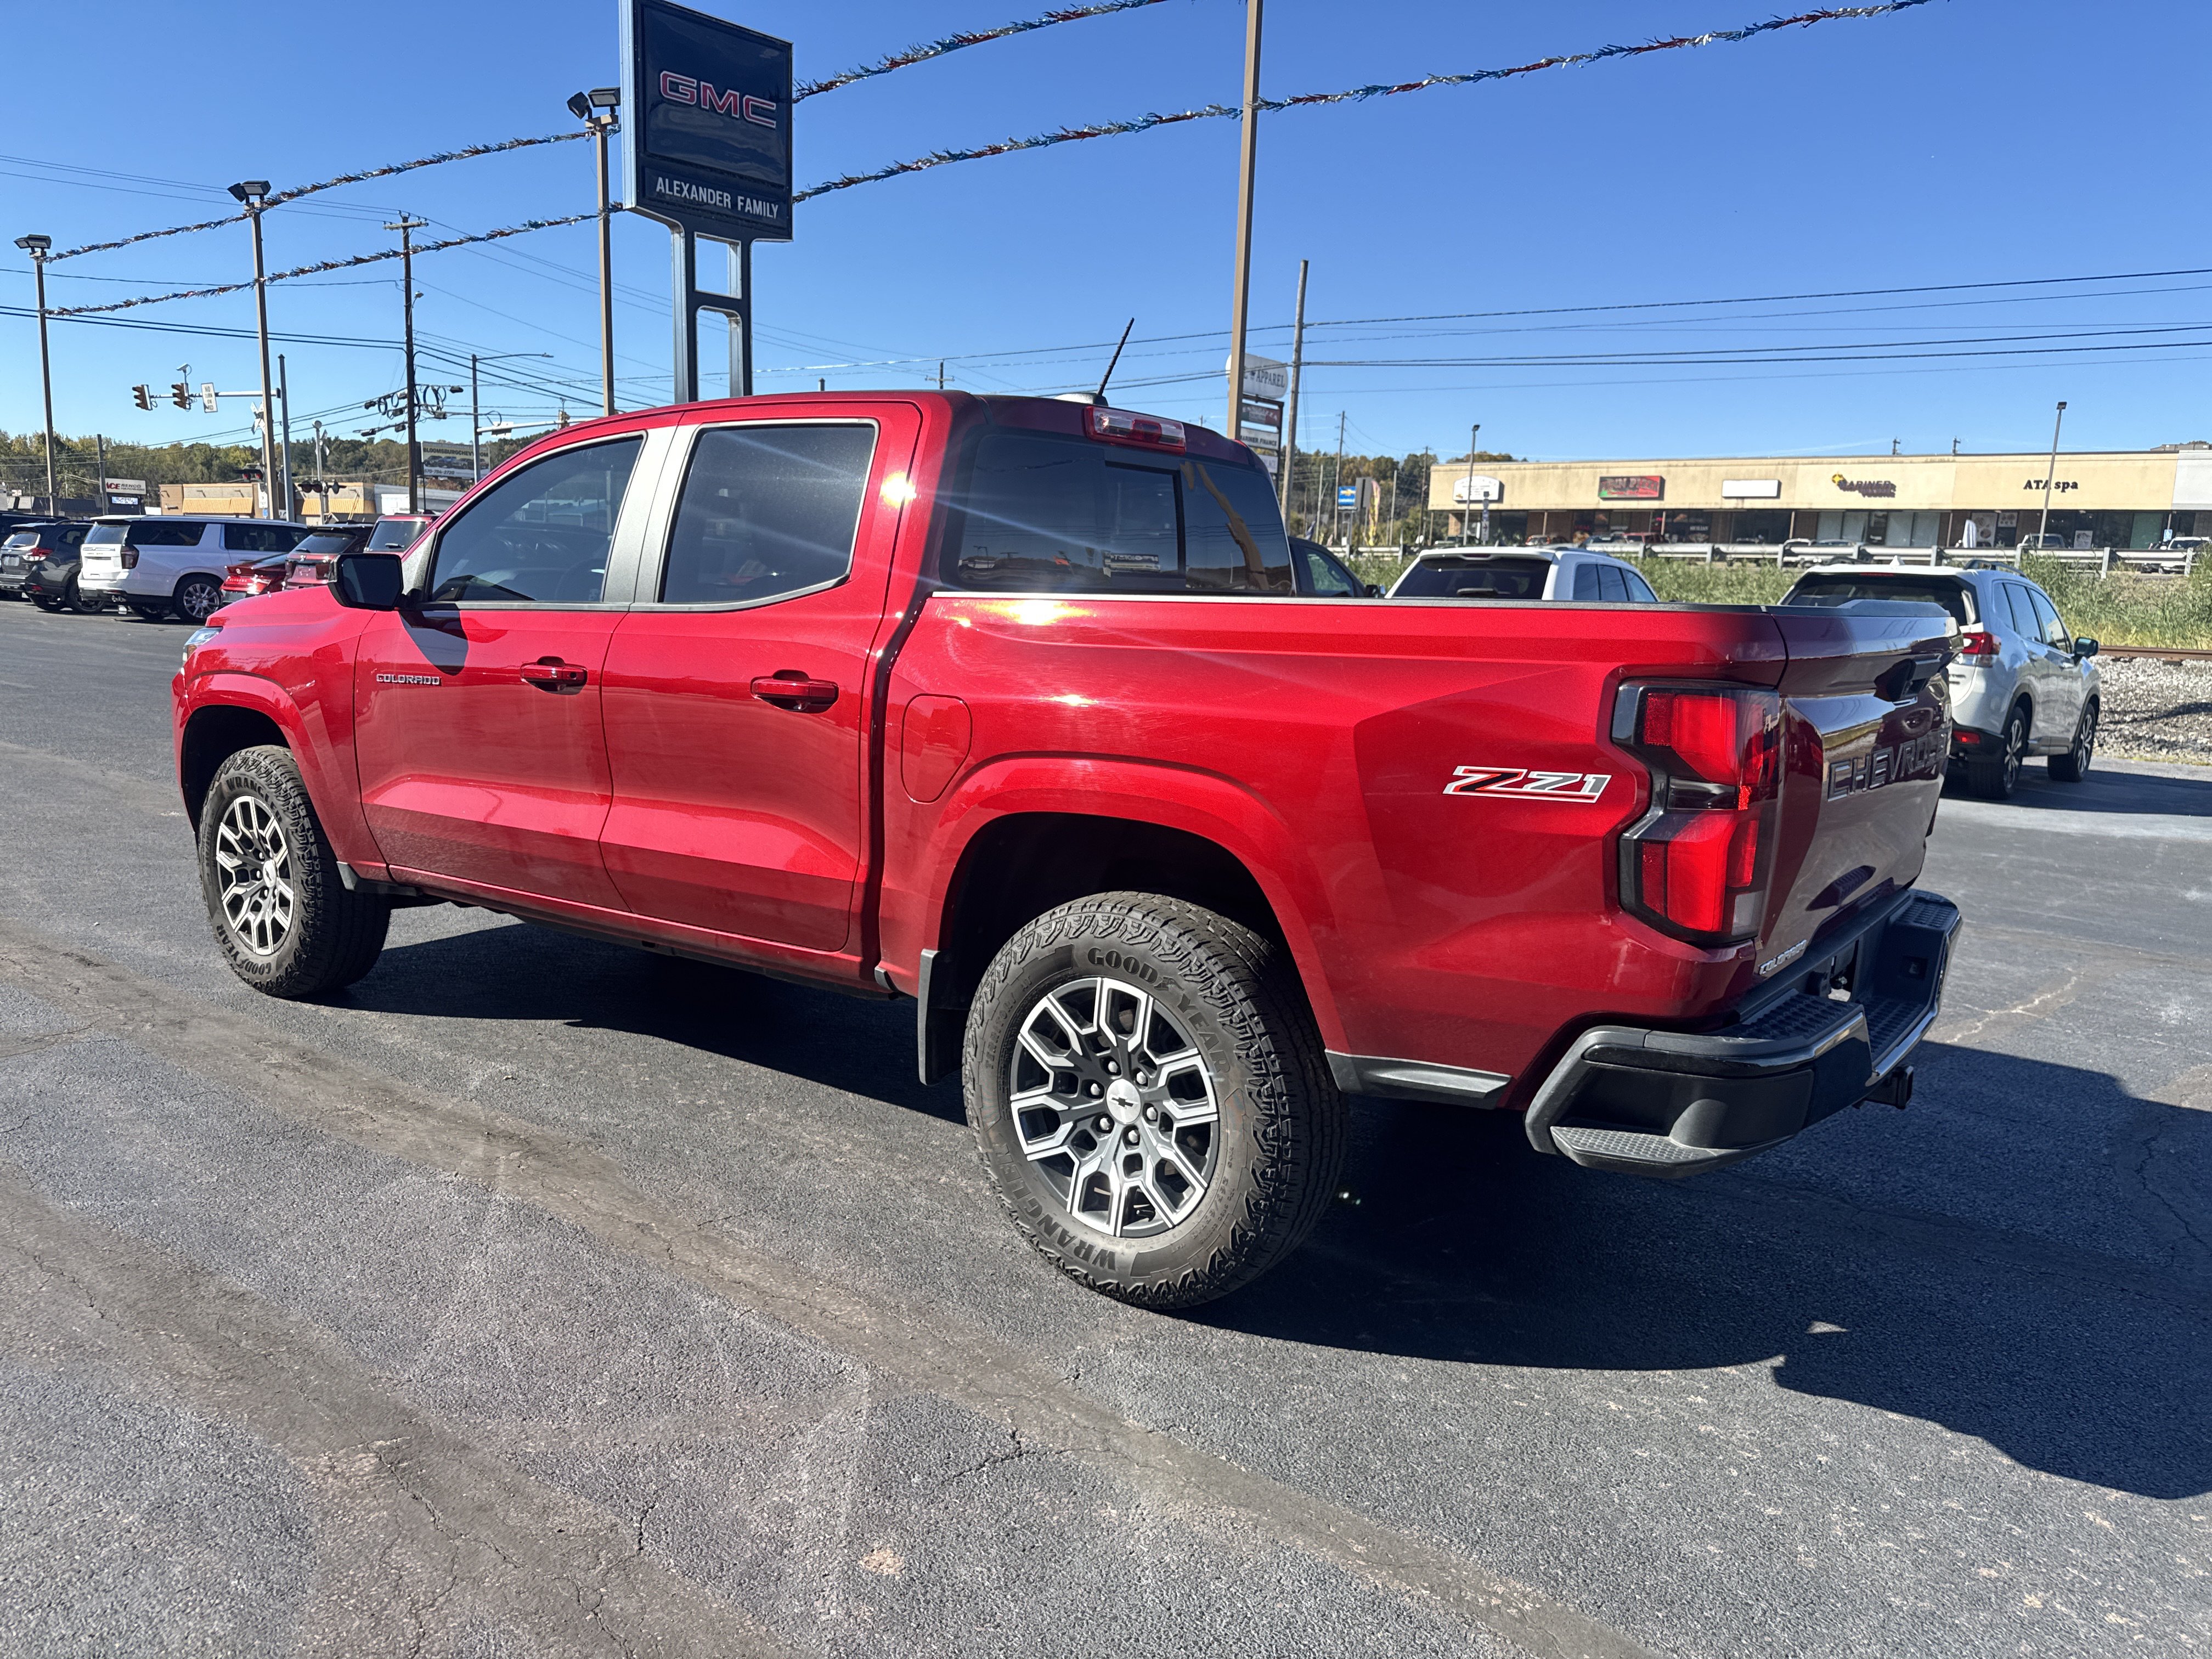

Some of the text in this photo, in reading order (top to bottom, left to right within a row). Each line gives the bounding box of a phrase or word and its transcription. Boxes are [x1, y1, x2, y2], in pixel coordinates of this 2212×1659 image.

[660, 70, 776, 128] GMC
[656, 177, 778, 219] ALEXANDER FAMILY
[1256, 370, 1285, 388] APPAREL
[2023, 479, 2078, 493] ATA spa
[376, 674, 440, 685] COLORADO
[1442, 765, 1612, 804] Z71
[992, 1143, 1116, 1271] WRANGLER
